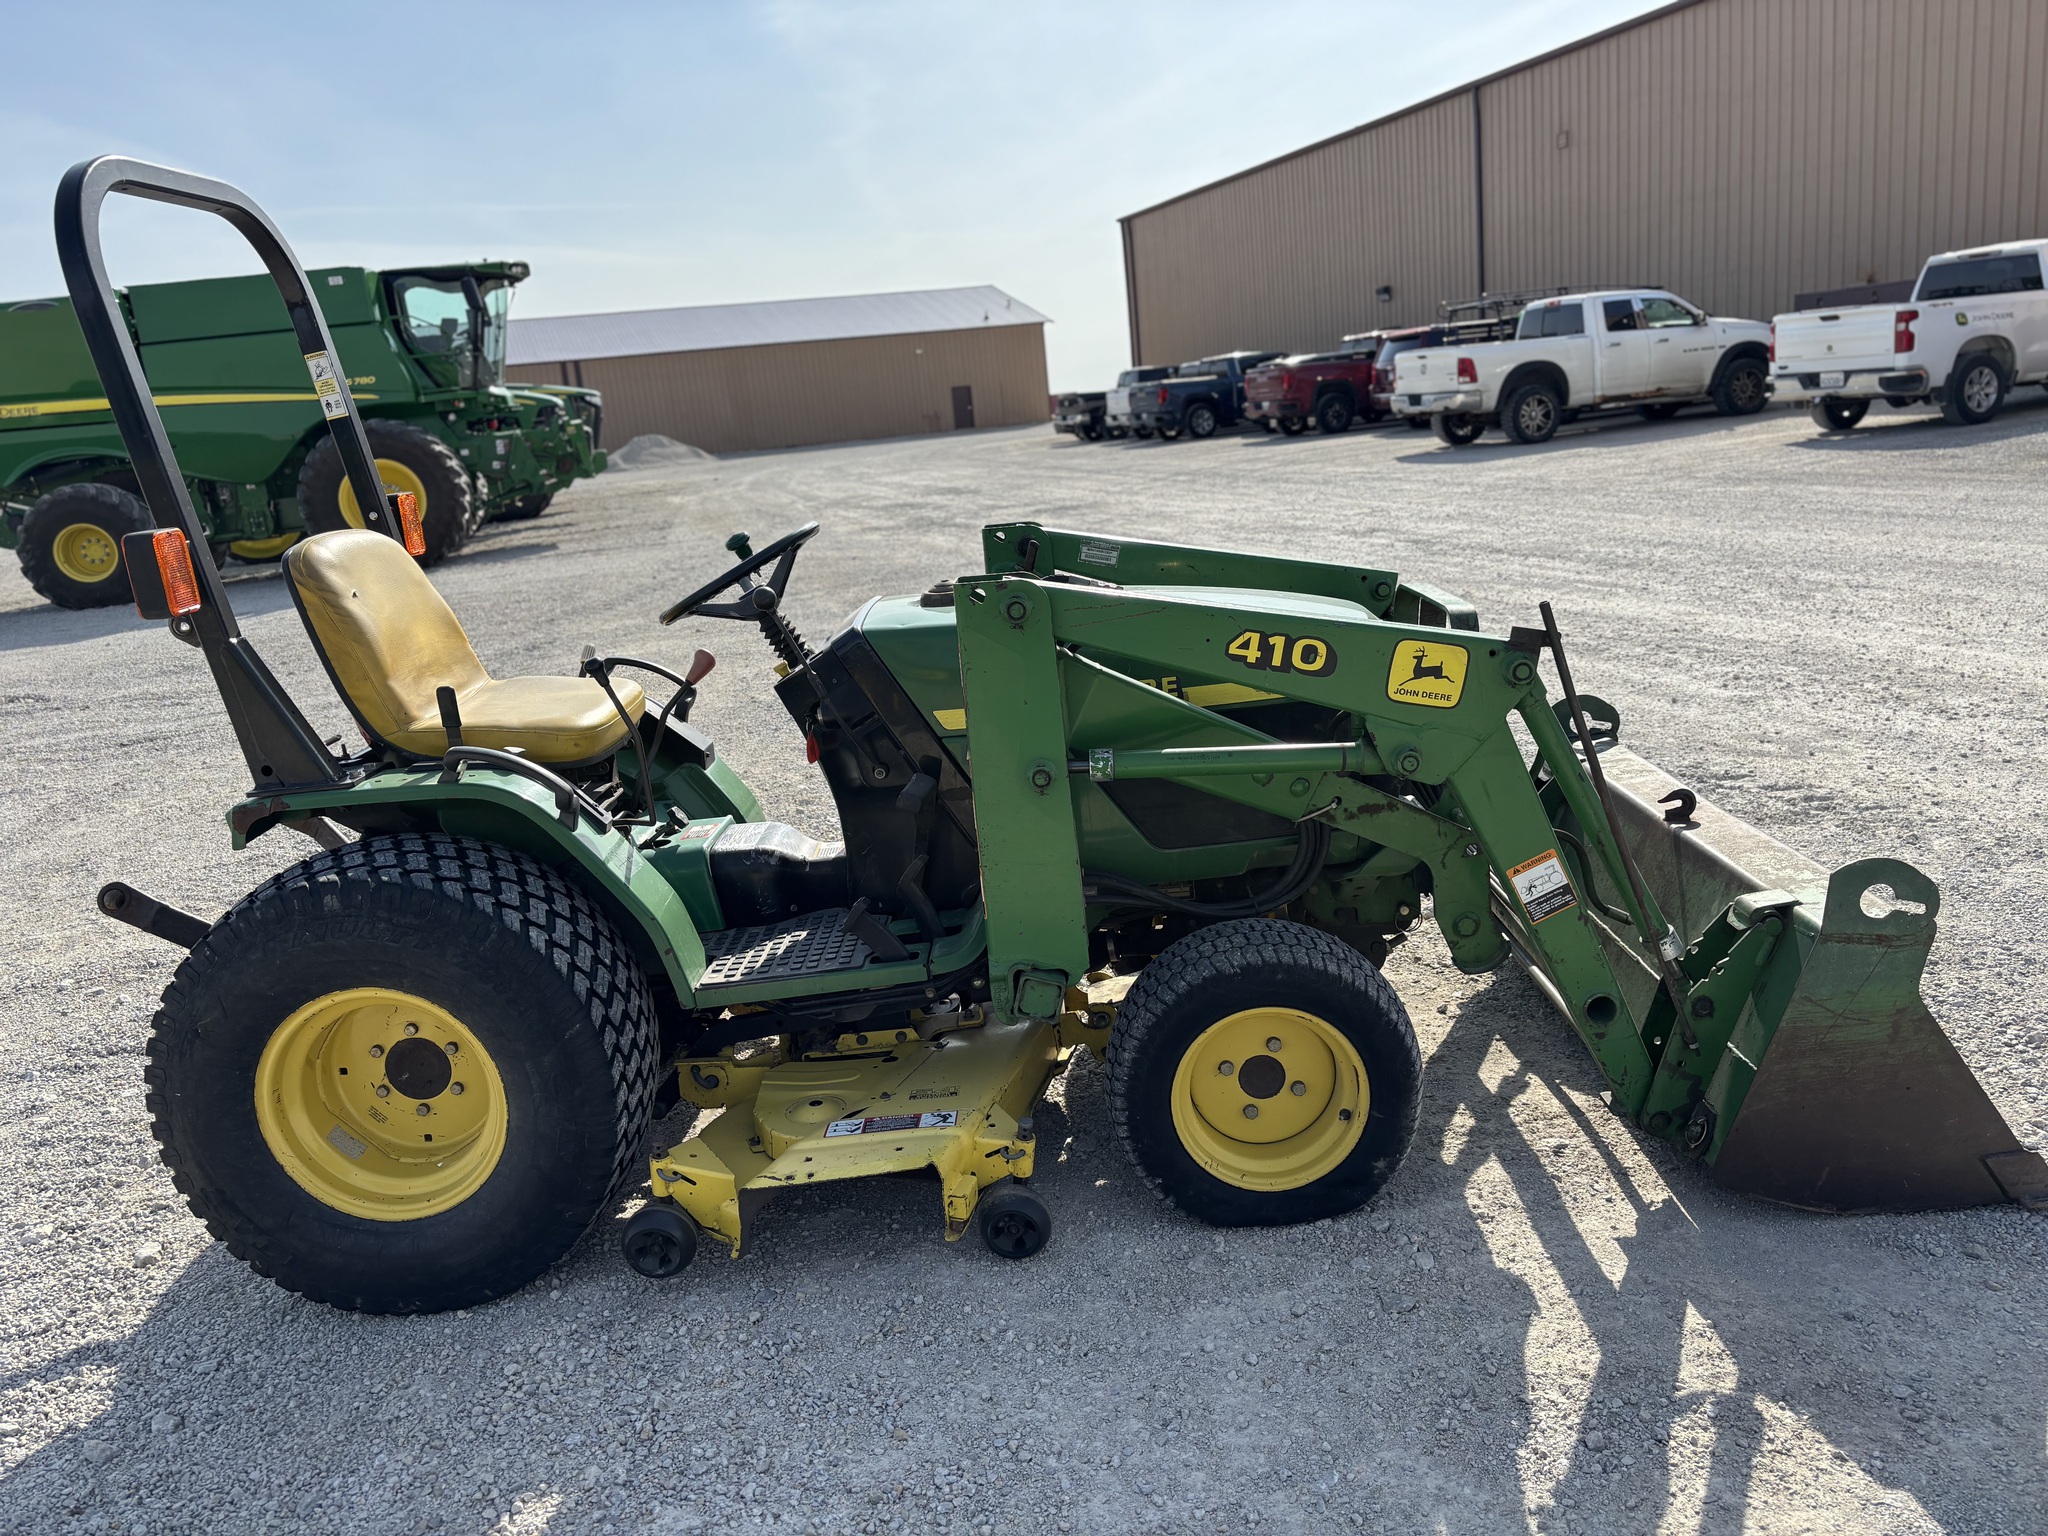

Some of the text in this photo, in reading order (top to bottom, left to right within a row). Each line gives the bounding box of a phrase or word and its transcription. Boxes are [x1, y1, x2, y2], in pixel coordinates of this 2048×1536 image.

[1228, 631, 1328, 671] 410
[1393, 687, 1453, 702] JOHN DEERE
[1520, 852, 1552, 870] WARNING
